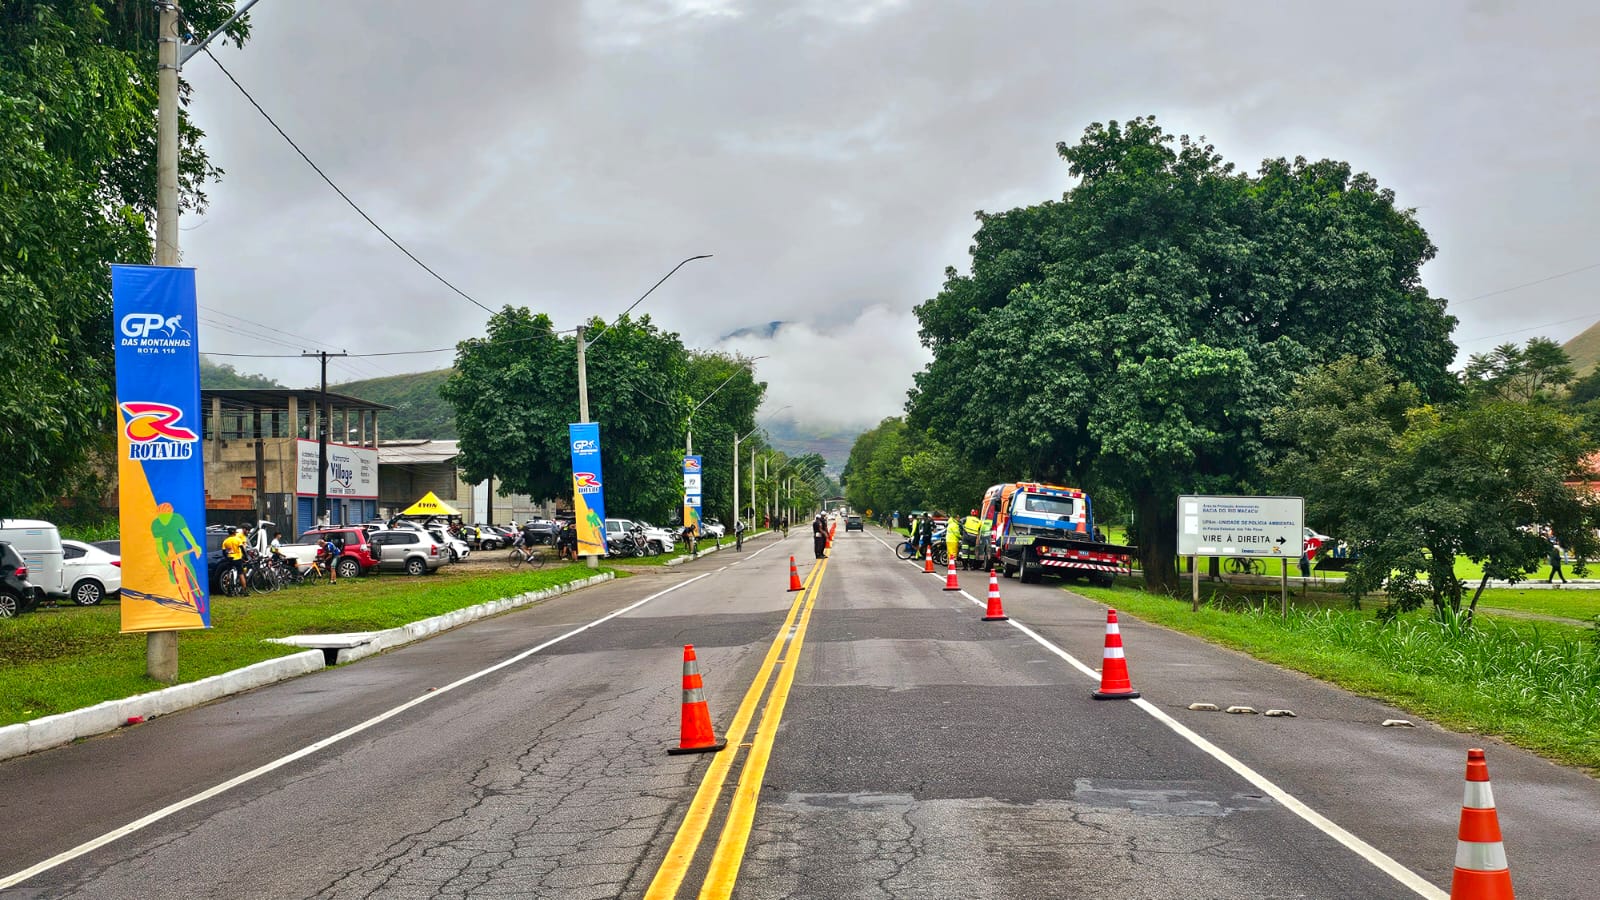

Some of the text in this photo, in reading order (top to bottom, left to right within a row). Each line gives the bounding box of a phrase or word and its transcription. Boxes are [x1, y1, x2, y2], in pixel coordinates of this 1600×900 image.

[120, 313, 164, 338] GP
[130, 443, 168, 458] ROTA
[330, 462, 352, 486] Village
